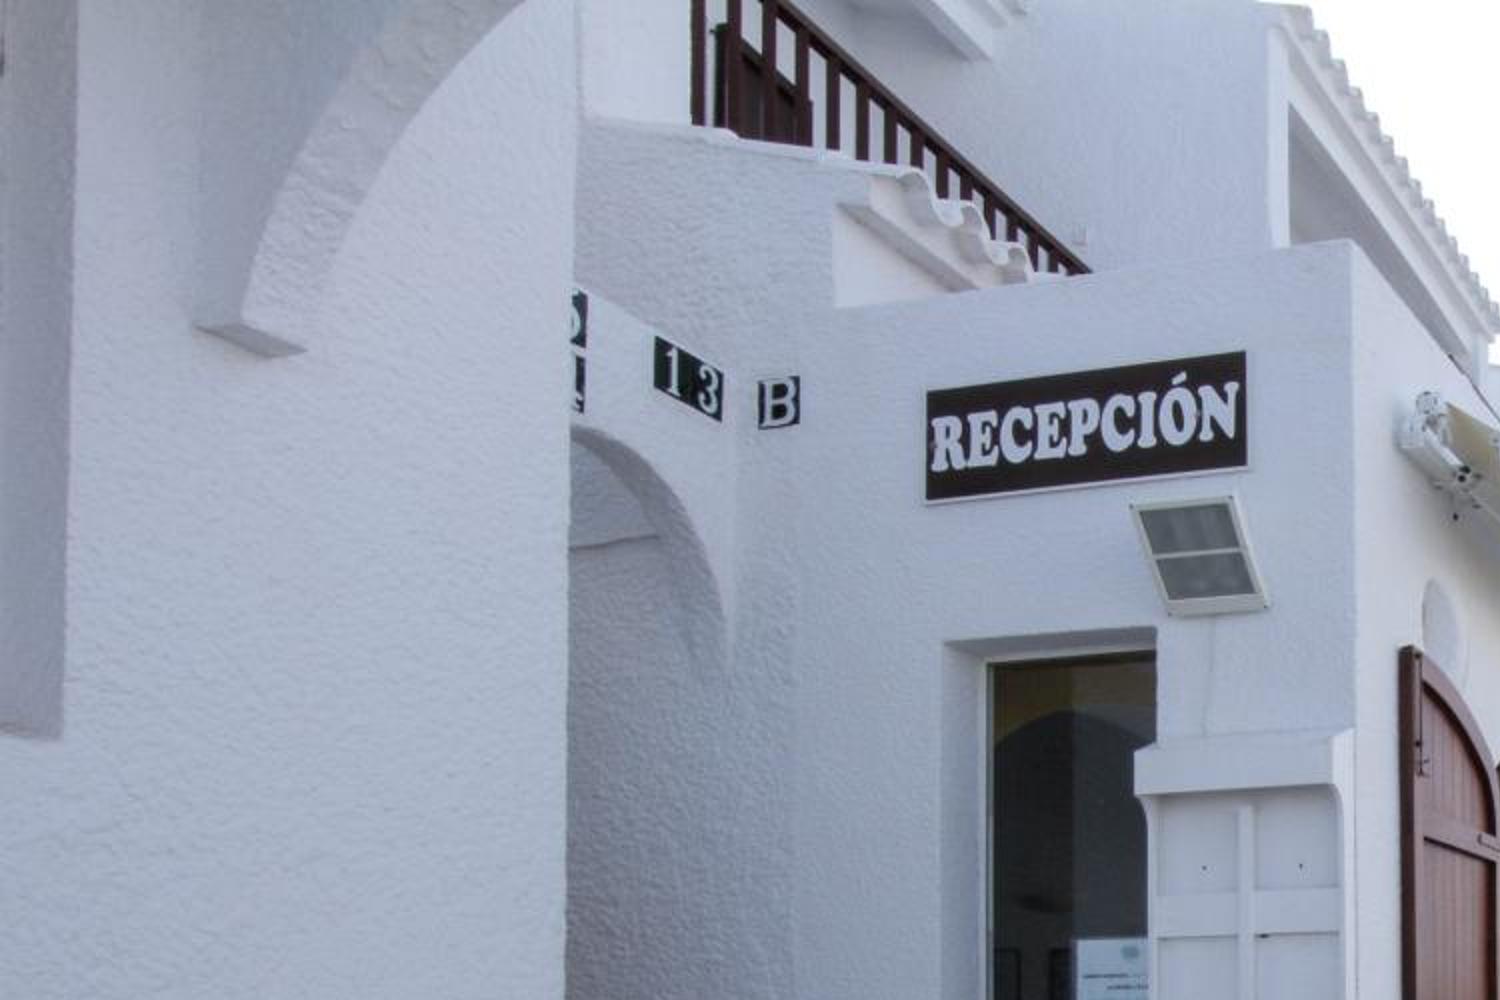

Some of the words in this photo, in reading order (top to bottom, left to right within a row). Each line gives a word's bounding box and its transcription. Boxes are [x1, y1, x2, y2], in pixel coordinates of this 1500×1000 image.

[665, 346, 719, 414] 13
[760, 376, 797, 427] B
[930, 371, 1239, 473] RECEPCIÓN
